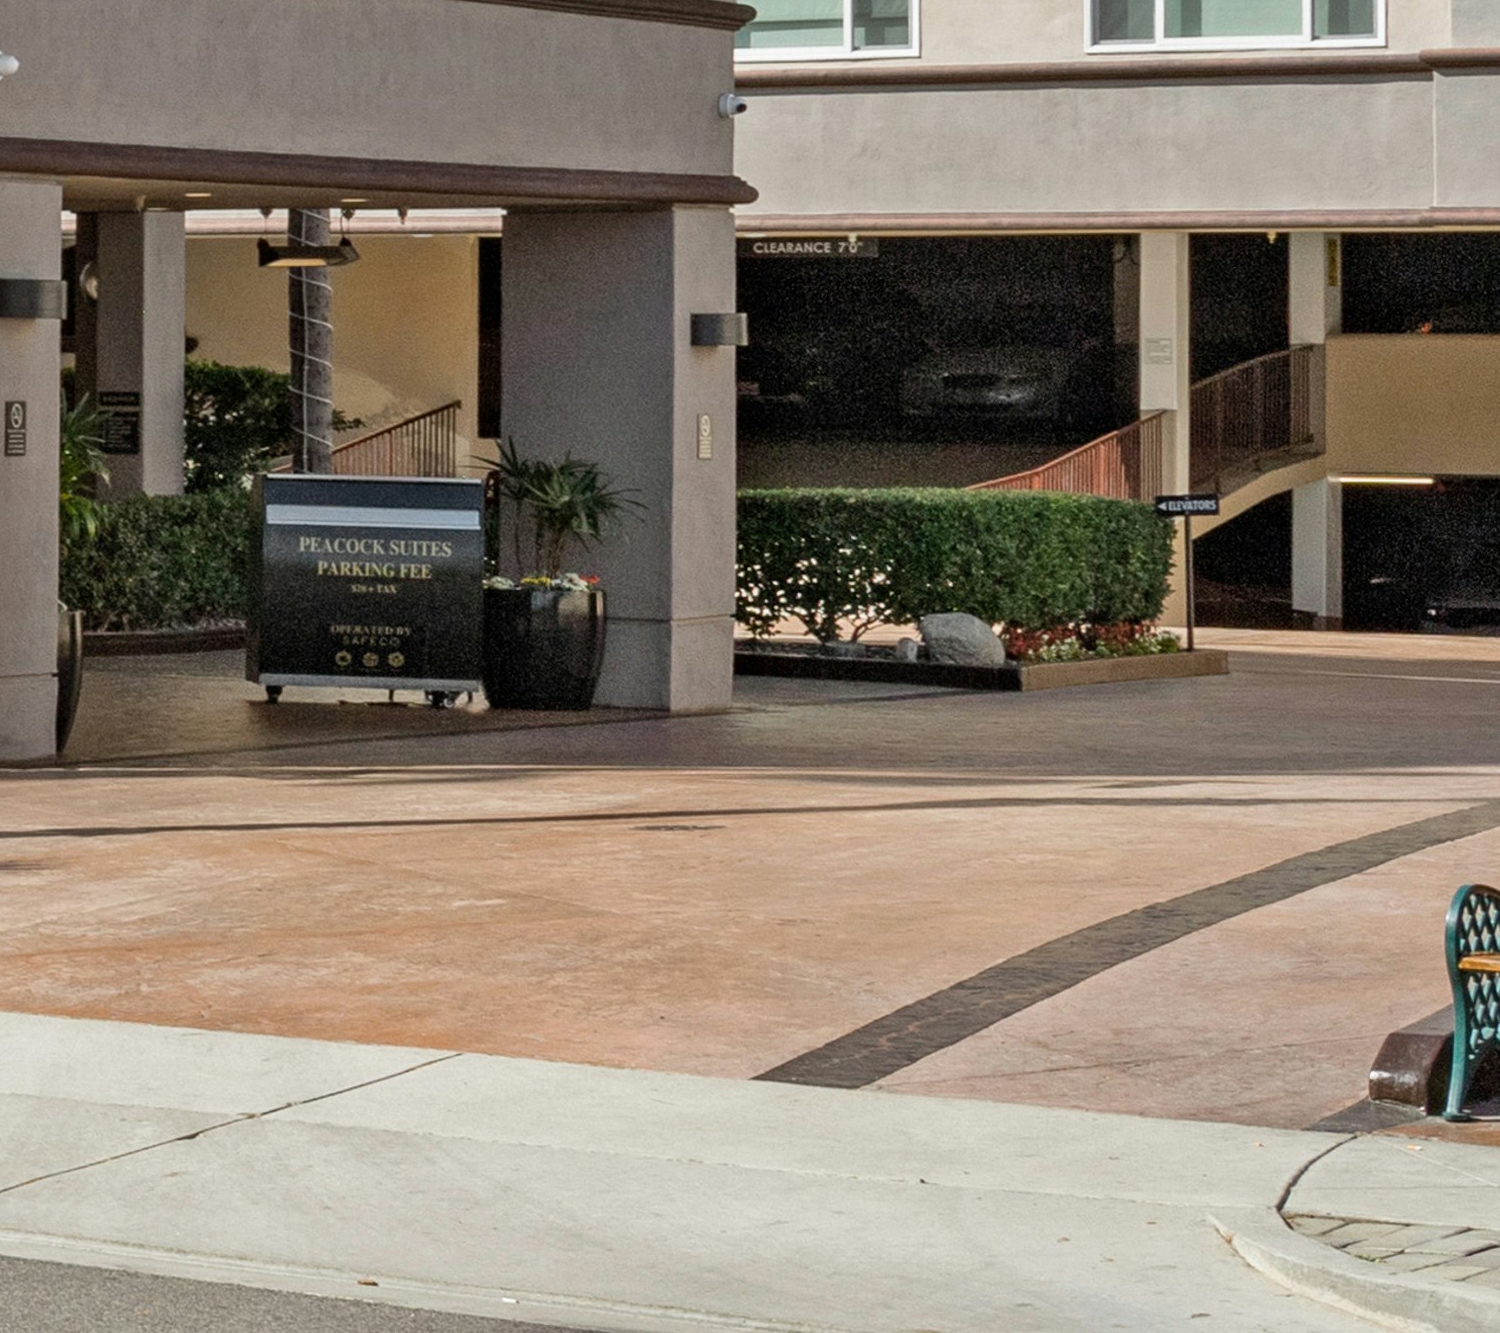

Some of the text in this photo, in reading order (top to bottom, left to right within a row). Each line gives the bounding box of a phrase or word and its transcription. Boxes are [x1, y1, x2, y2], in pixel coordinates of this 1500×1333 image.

[752, 242, 831, 254] CLEARANCE
[1168, 499, 1217, 512] ELEVATORS
[299, 536, 452, 558] PEACOCK SUITES
[317, 560, 432, 580] PARKING FEE
